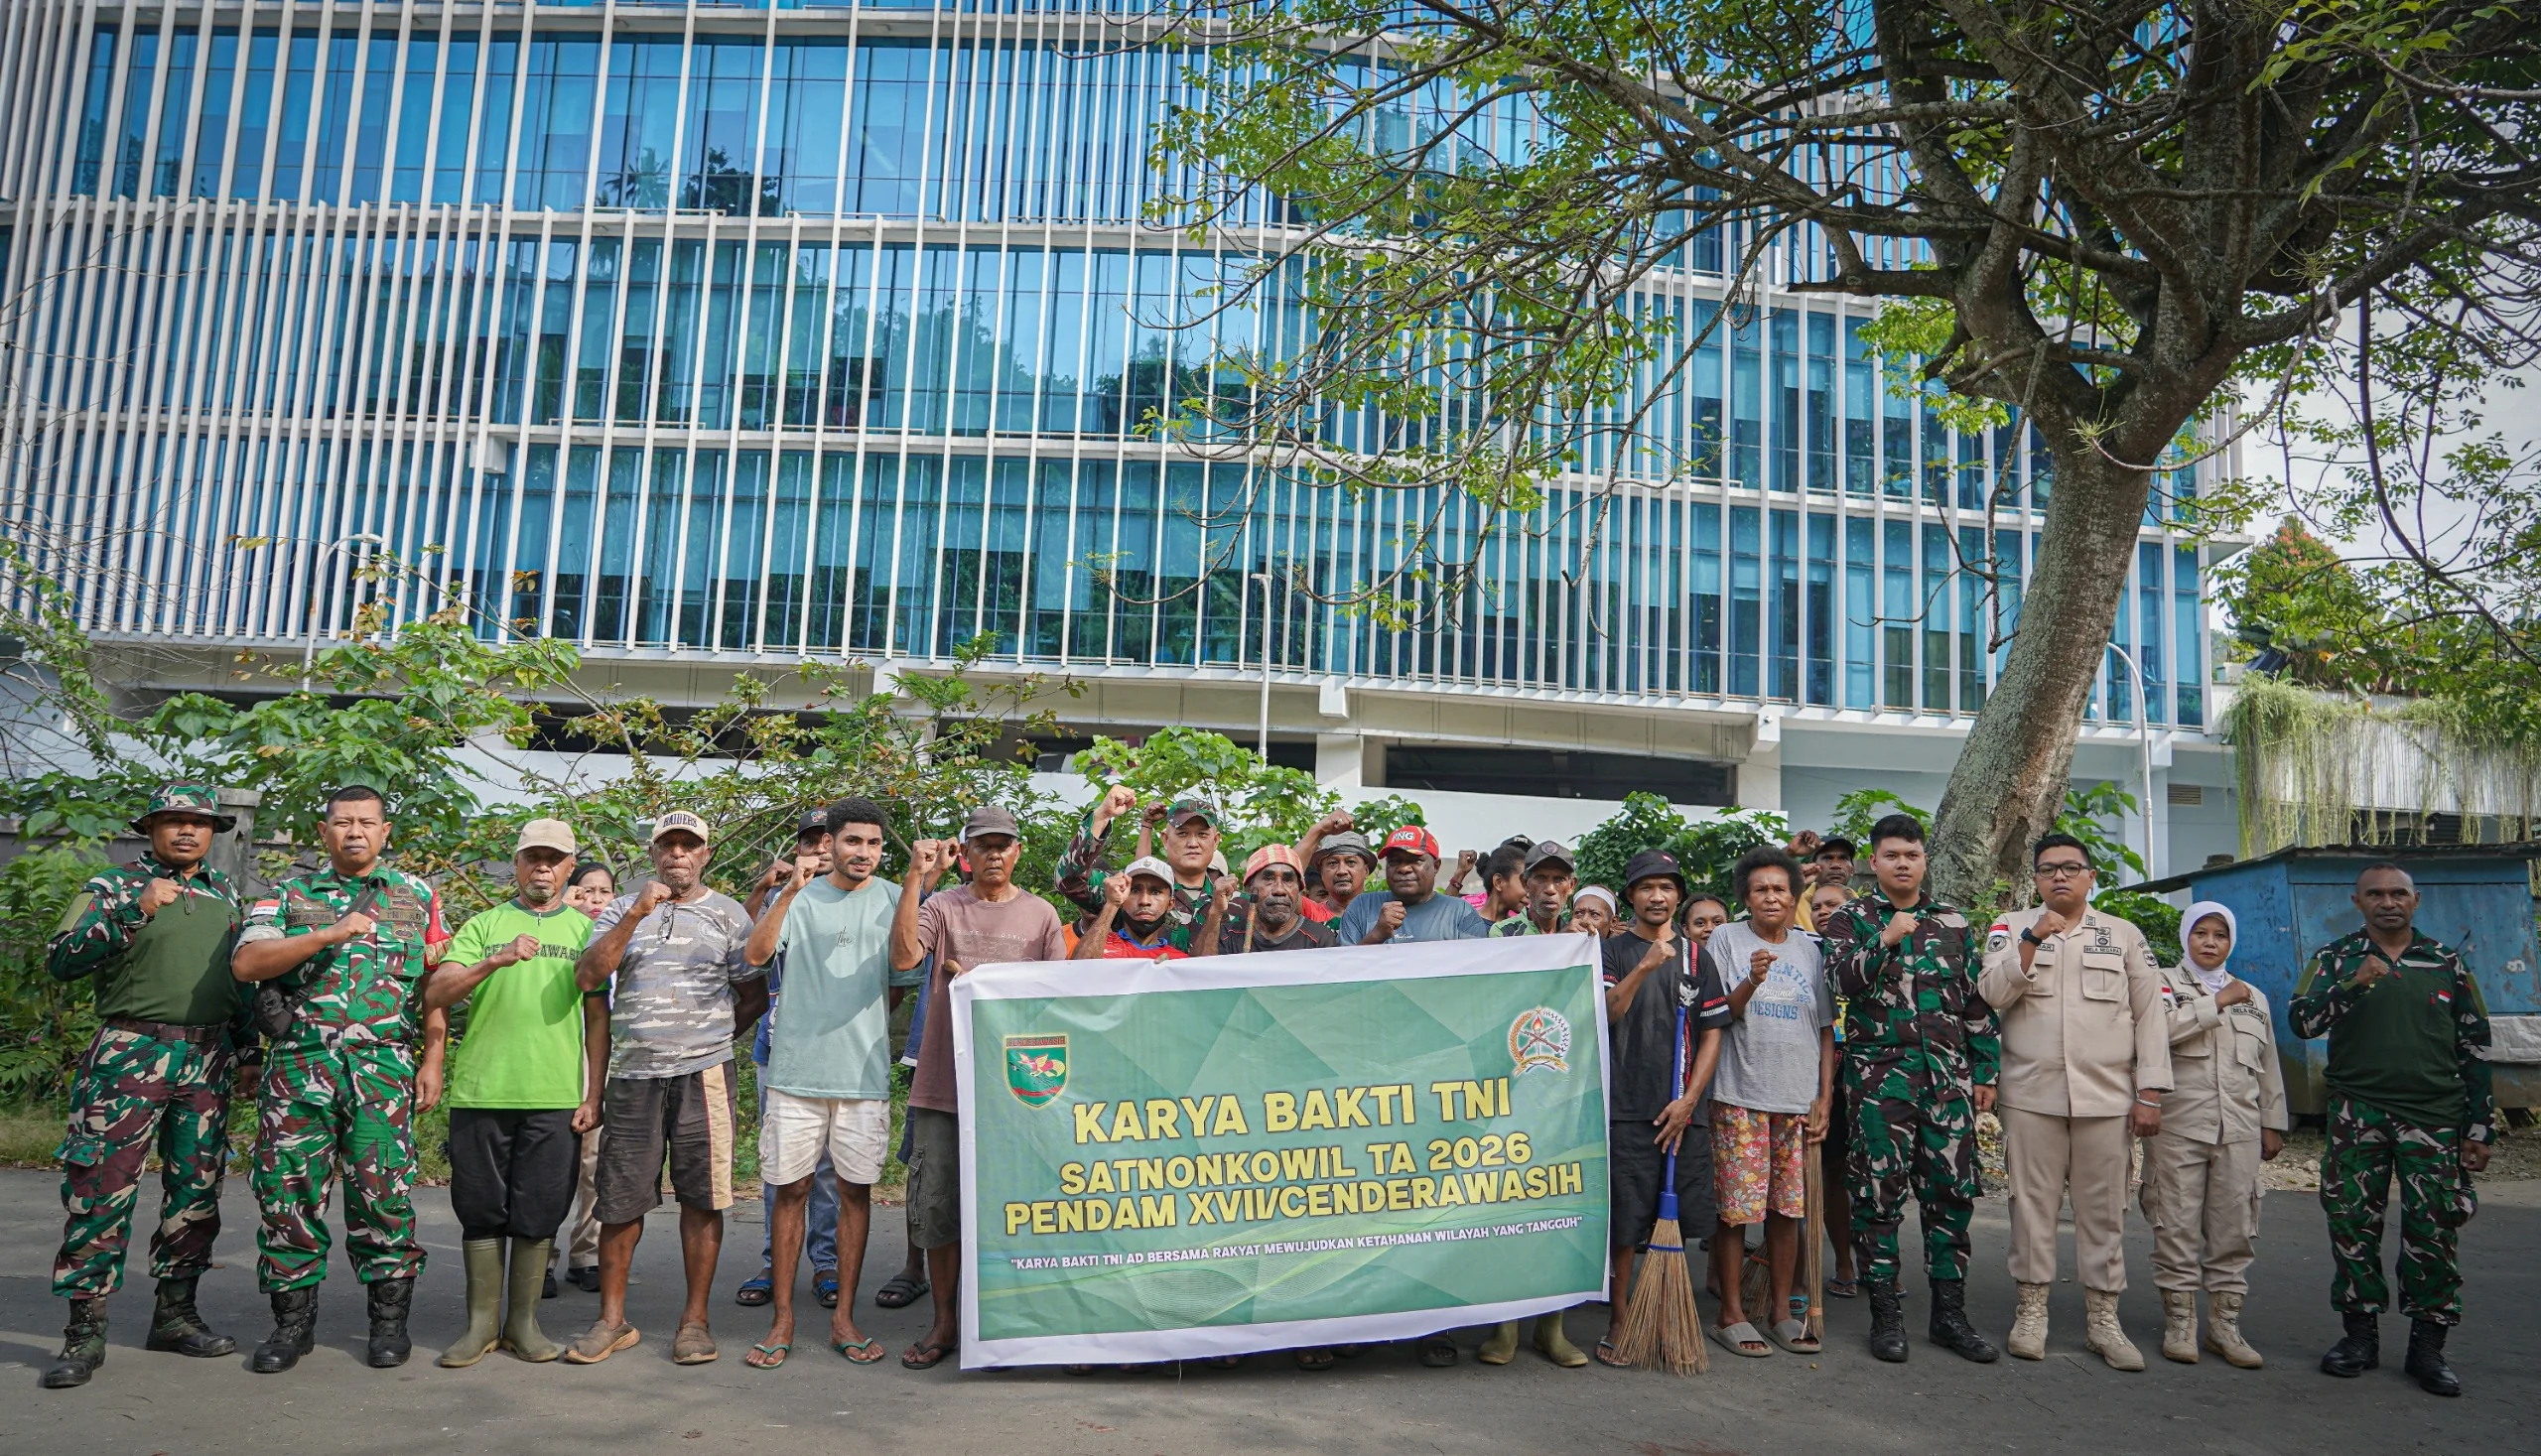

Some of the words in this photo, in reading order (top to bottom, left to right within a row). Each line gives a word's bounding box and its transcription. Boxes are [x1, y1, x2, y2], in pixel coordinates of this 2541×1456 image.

[1750, 1000, 1799, 1019] DESIGNS
[1073, 1094, 1249, 1144] KARYA
[1264, 1084, 1416, 1132] BAKTI
[1430, 1077, 1511, 1123] TNI
[1060, 1145, 1357, 1196] SATNONKOWIL
[1367, 1141, 1417, 1176] TA
[1427, 1131, 1533, 1172] 2026
[1004, 1193, 1177, 1236] PENDAM
[1188, 1161, 1583, 1226] XVII/CENDERAWASIH
[1010, 1256, 1059, 1269] "KARYA
[1061, 1255, 1099, 1267] BAKTI
[1103, 1254, 1123, 1265] TNI
[1127, 1253, 1144, 1264] AD
[1147, 1249, 1210, 1263] BERSAMA
[1212, 1244, 1261, 1258] RAKYAT
[1264, 1238, 1354, 1255] MEWUJUDKAN
[1357, 1232, 1432, 1249] KETAHANAN
[1435, 1227, 1490, 1242] WILAYAH
[1492, 1223, 1525, 1238] YANG
[1527, 1216, 1583, 1234] TANGGUH"
